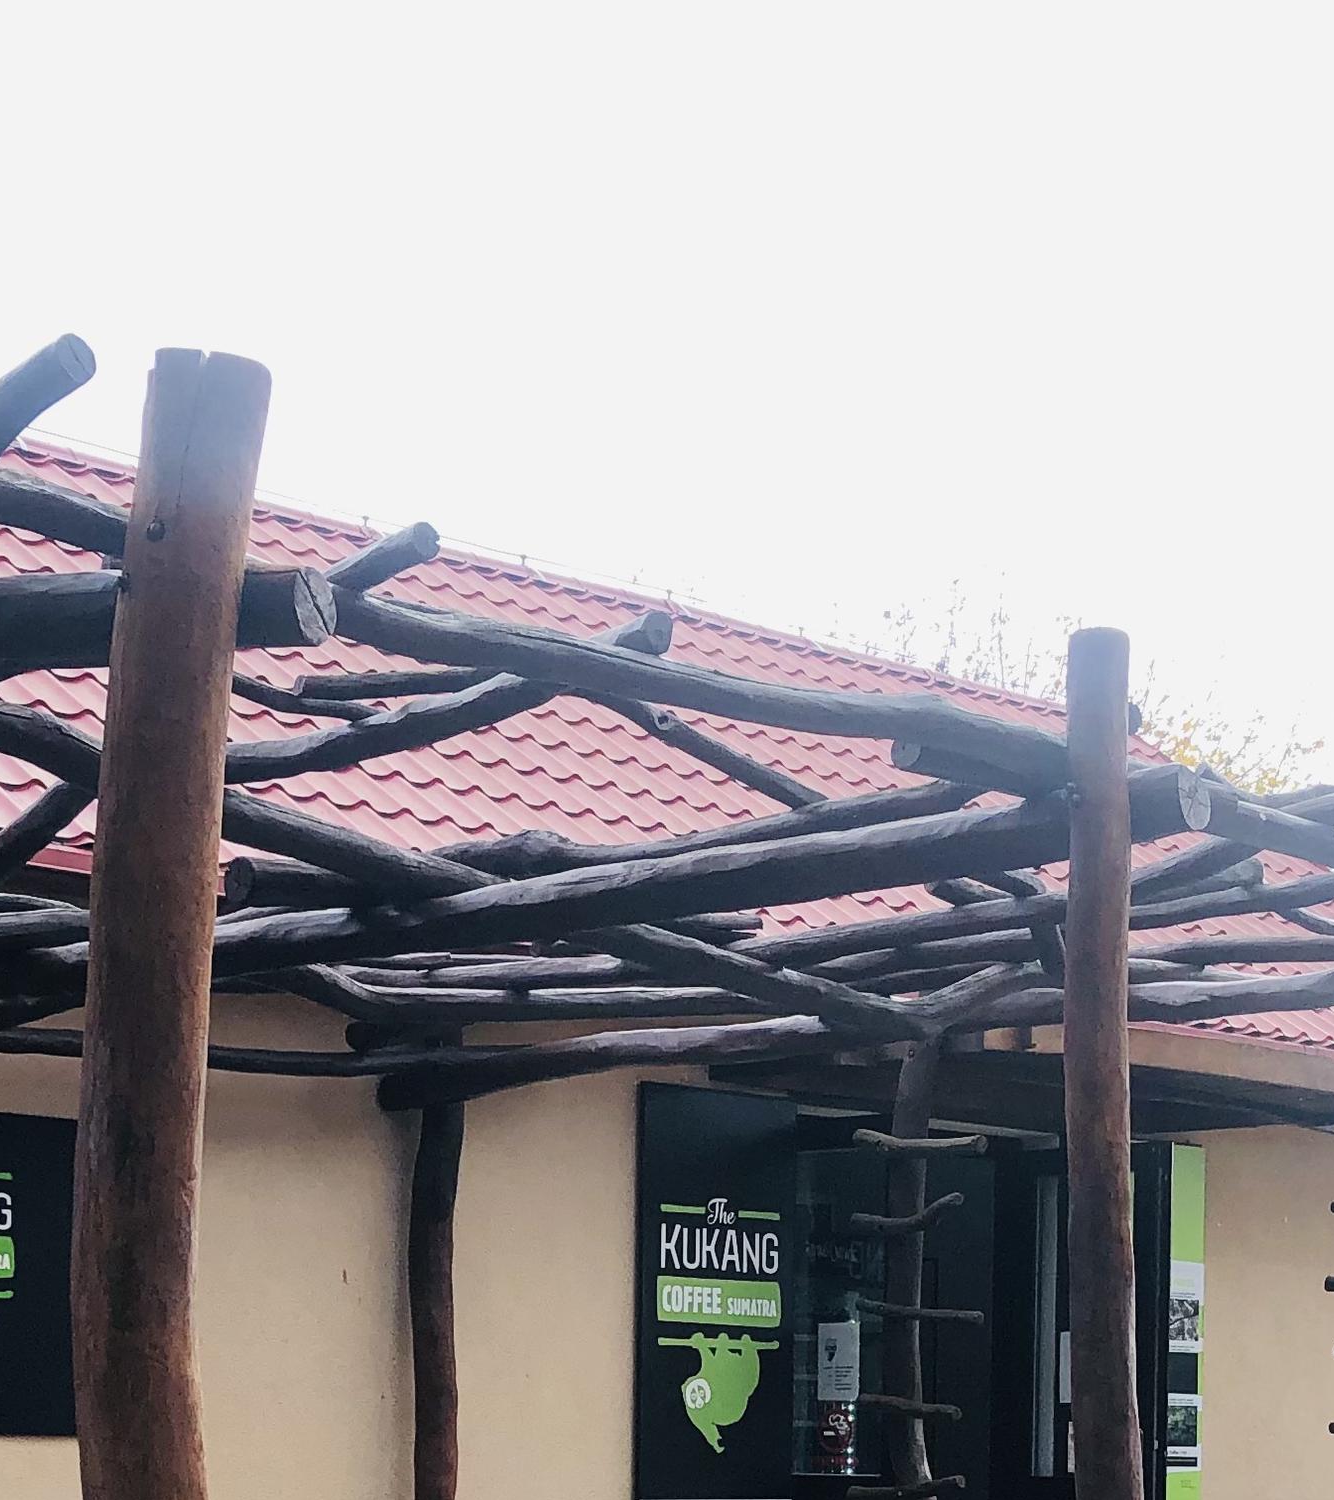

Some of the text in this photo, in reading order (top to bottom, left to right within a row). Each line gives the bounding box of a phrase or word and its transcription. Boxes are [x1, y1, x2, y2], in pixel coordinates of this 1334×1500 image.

[707, 1197, 736, 1225] The
[659, 1222, 779, 1275] KUKANG
[662, 1285, 777, 1318] COFFEE SUMATRA
